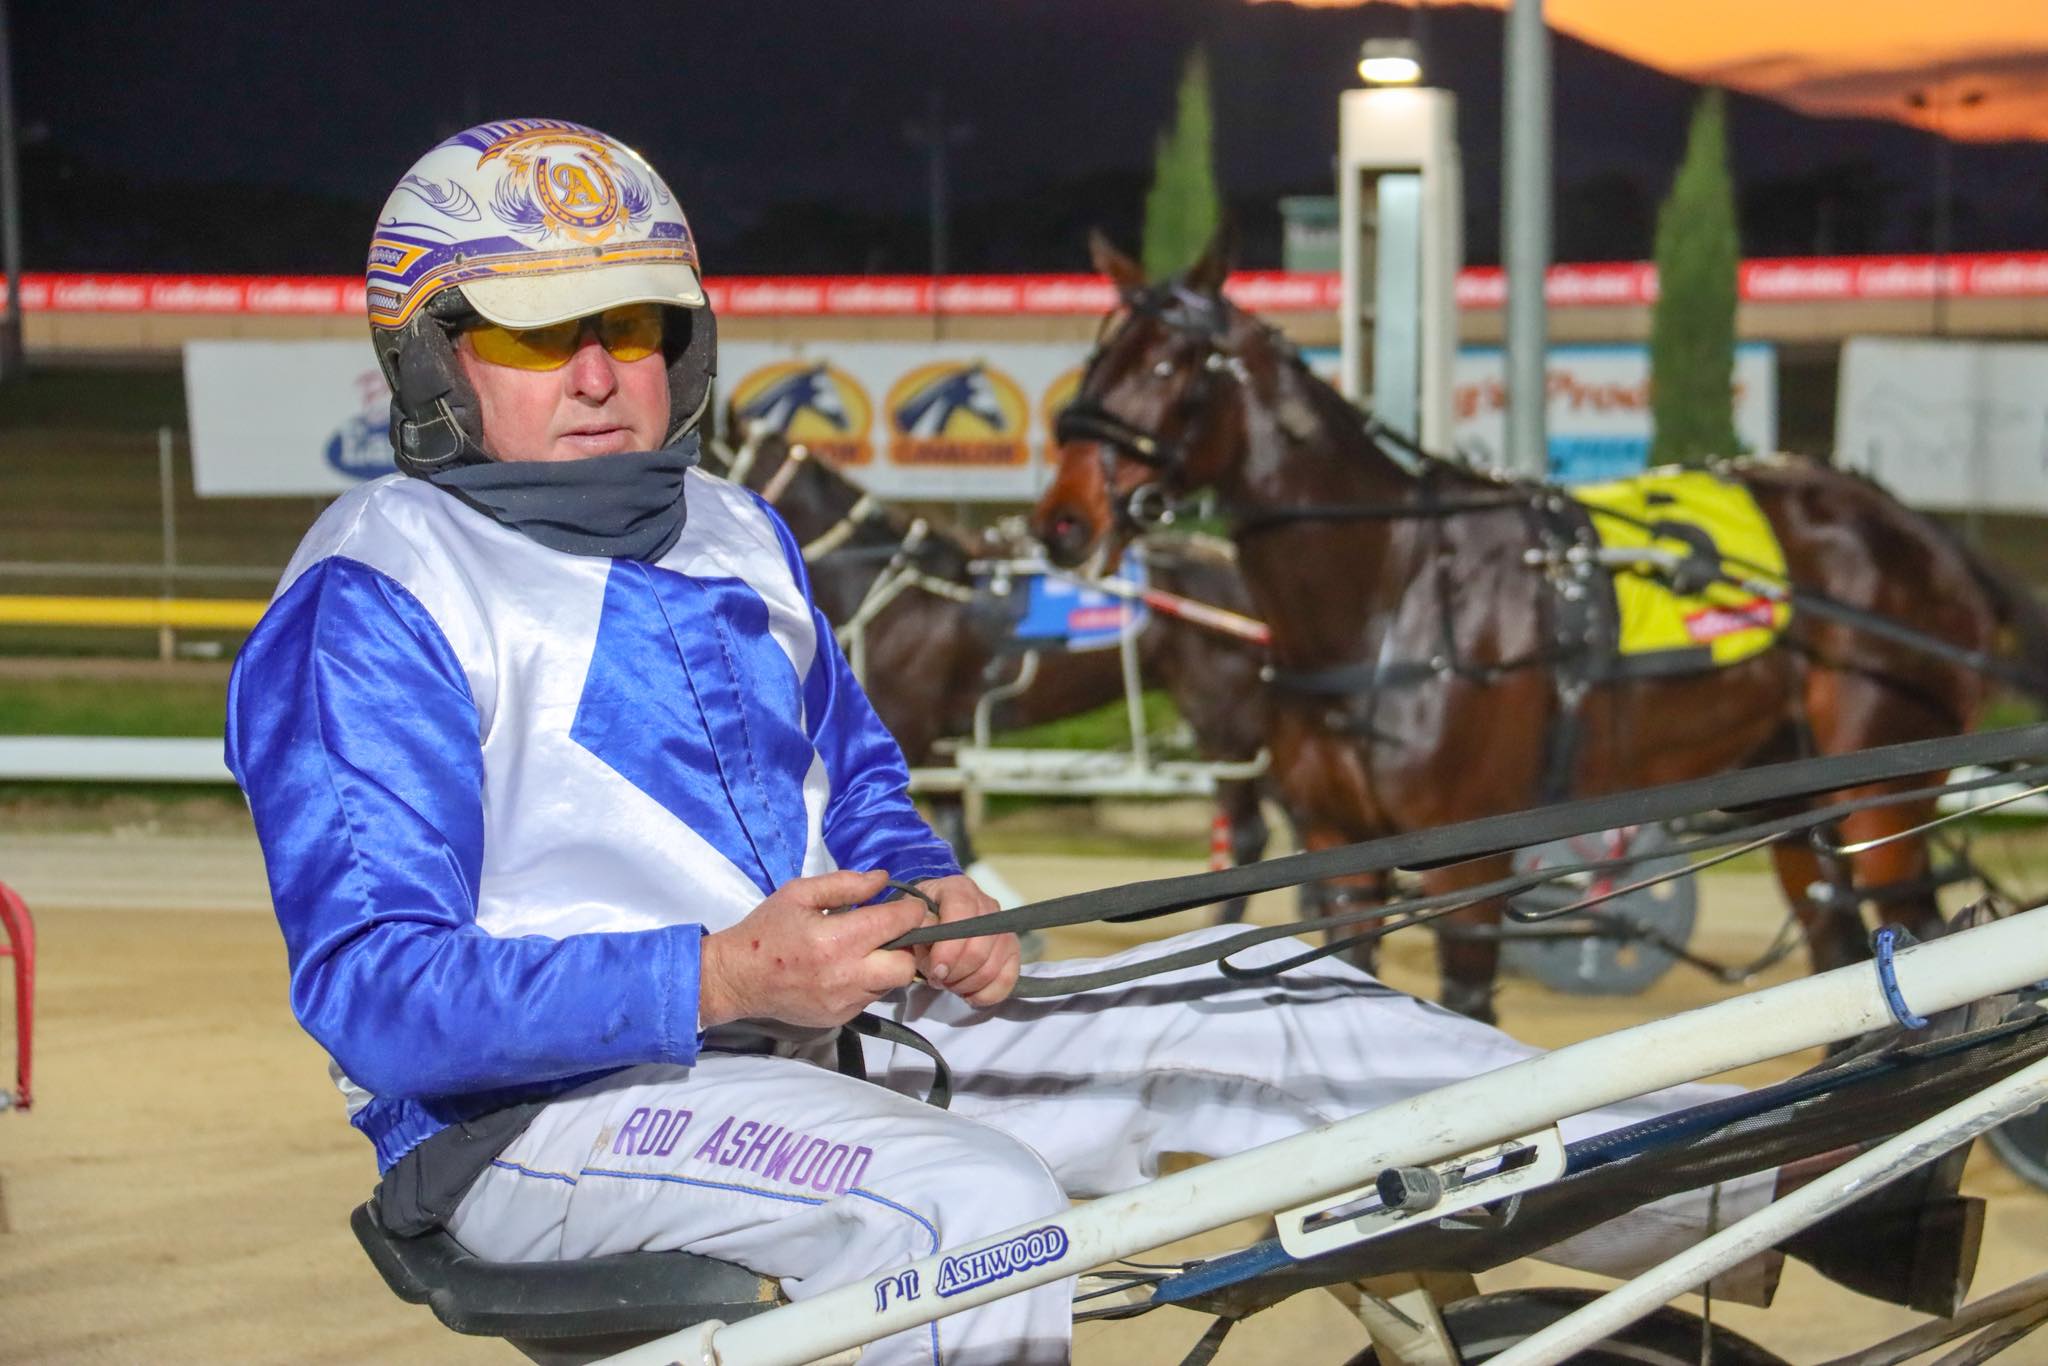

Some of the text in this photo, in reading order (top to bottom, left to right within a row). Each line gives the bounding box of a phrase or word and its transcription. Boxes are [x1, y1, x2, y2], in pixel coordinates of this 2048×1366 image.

[612, 1106, 873, 1196] ROD ASHWOOD
[938, 1227, 1066, 1295] ASHWOOD
